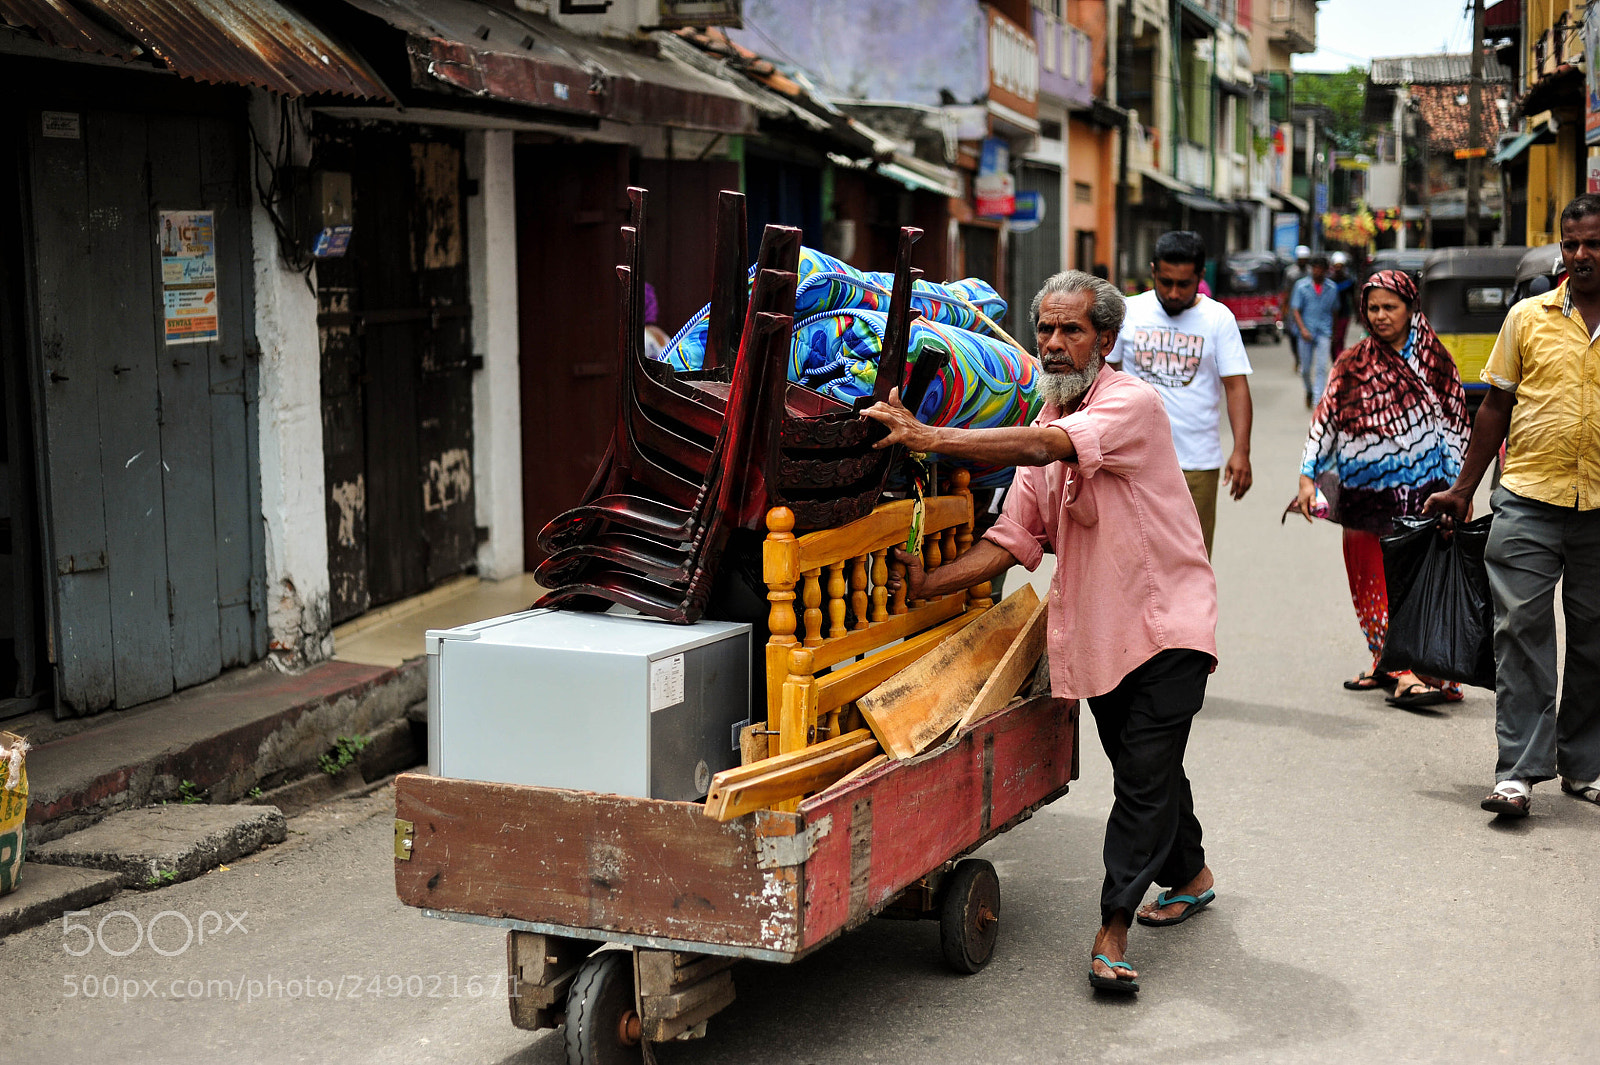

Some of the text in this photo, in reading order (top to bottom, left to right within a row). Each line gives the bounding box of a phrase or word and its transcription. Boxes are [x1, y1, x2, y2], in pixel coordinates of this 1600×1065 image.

[178, 225, 200, 241] ICT
[1133, 330, 1205, 358] RALPH
[1134, 349, 1201, 377] JEANS
